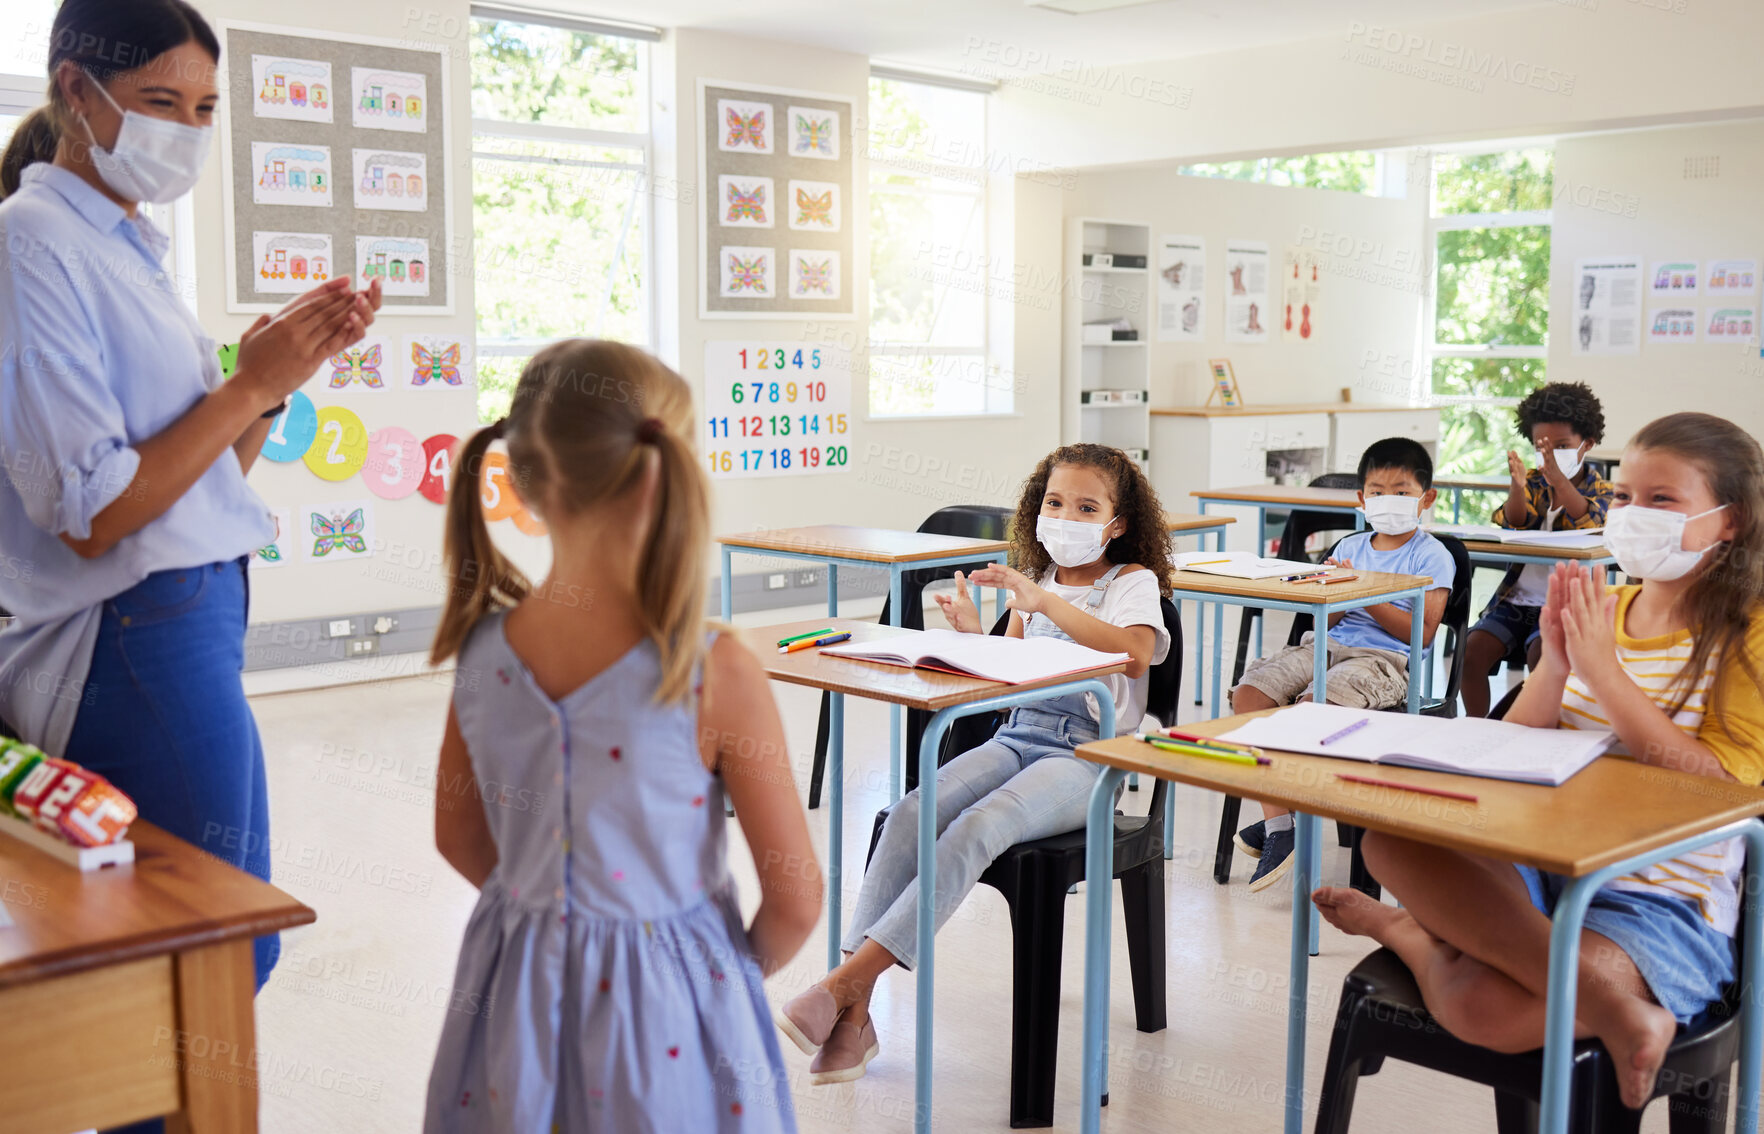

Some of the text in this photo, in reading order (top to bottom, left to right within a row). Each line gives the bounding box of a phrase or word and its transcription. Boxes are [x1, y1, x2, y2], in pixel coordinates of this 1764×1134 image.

[739, 348, 821, 369] 1 2 3 4 5
[732, 381, 826, 404] 6 7 8 9 10
[323, 420, 345, 464] 2
[708, 413, 848, 438] 11 12 13 14 15
[381, 443, 403, 484] 3
[429, 448, 450, 491] 4
[708, 445, 848, 473] 16 17 18 19 20
[481, 466, 504, 508] 5
